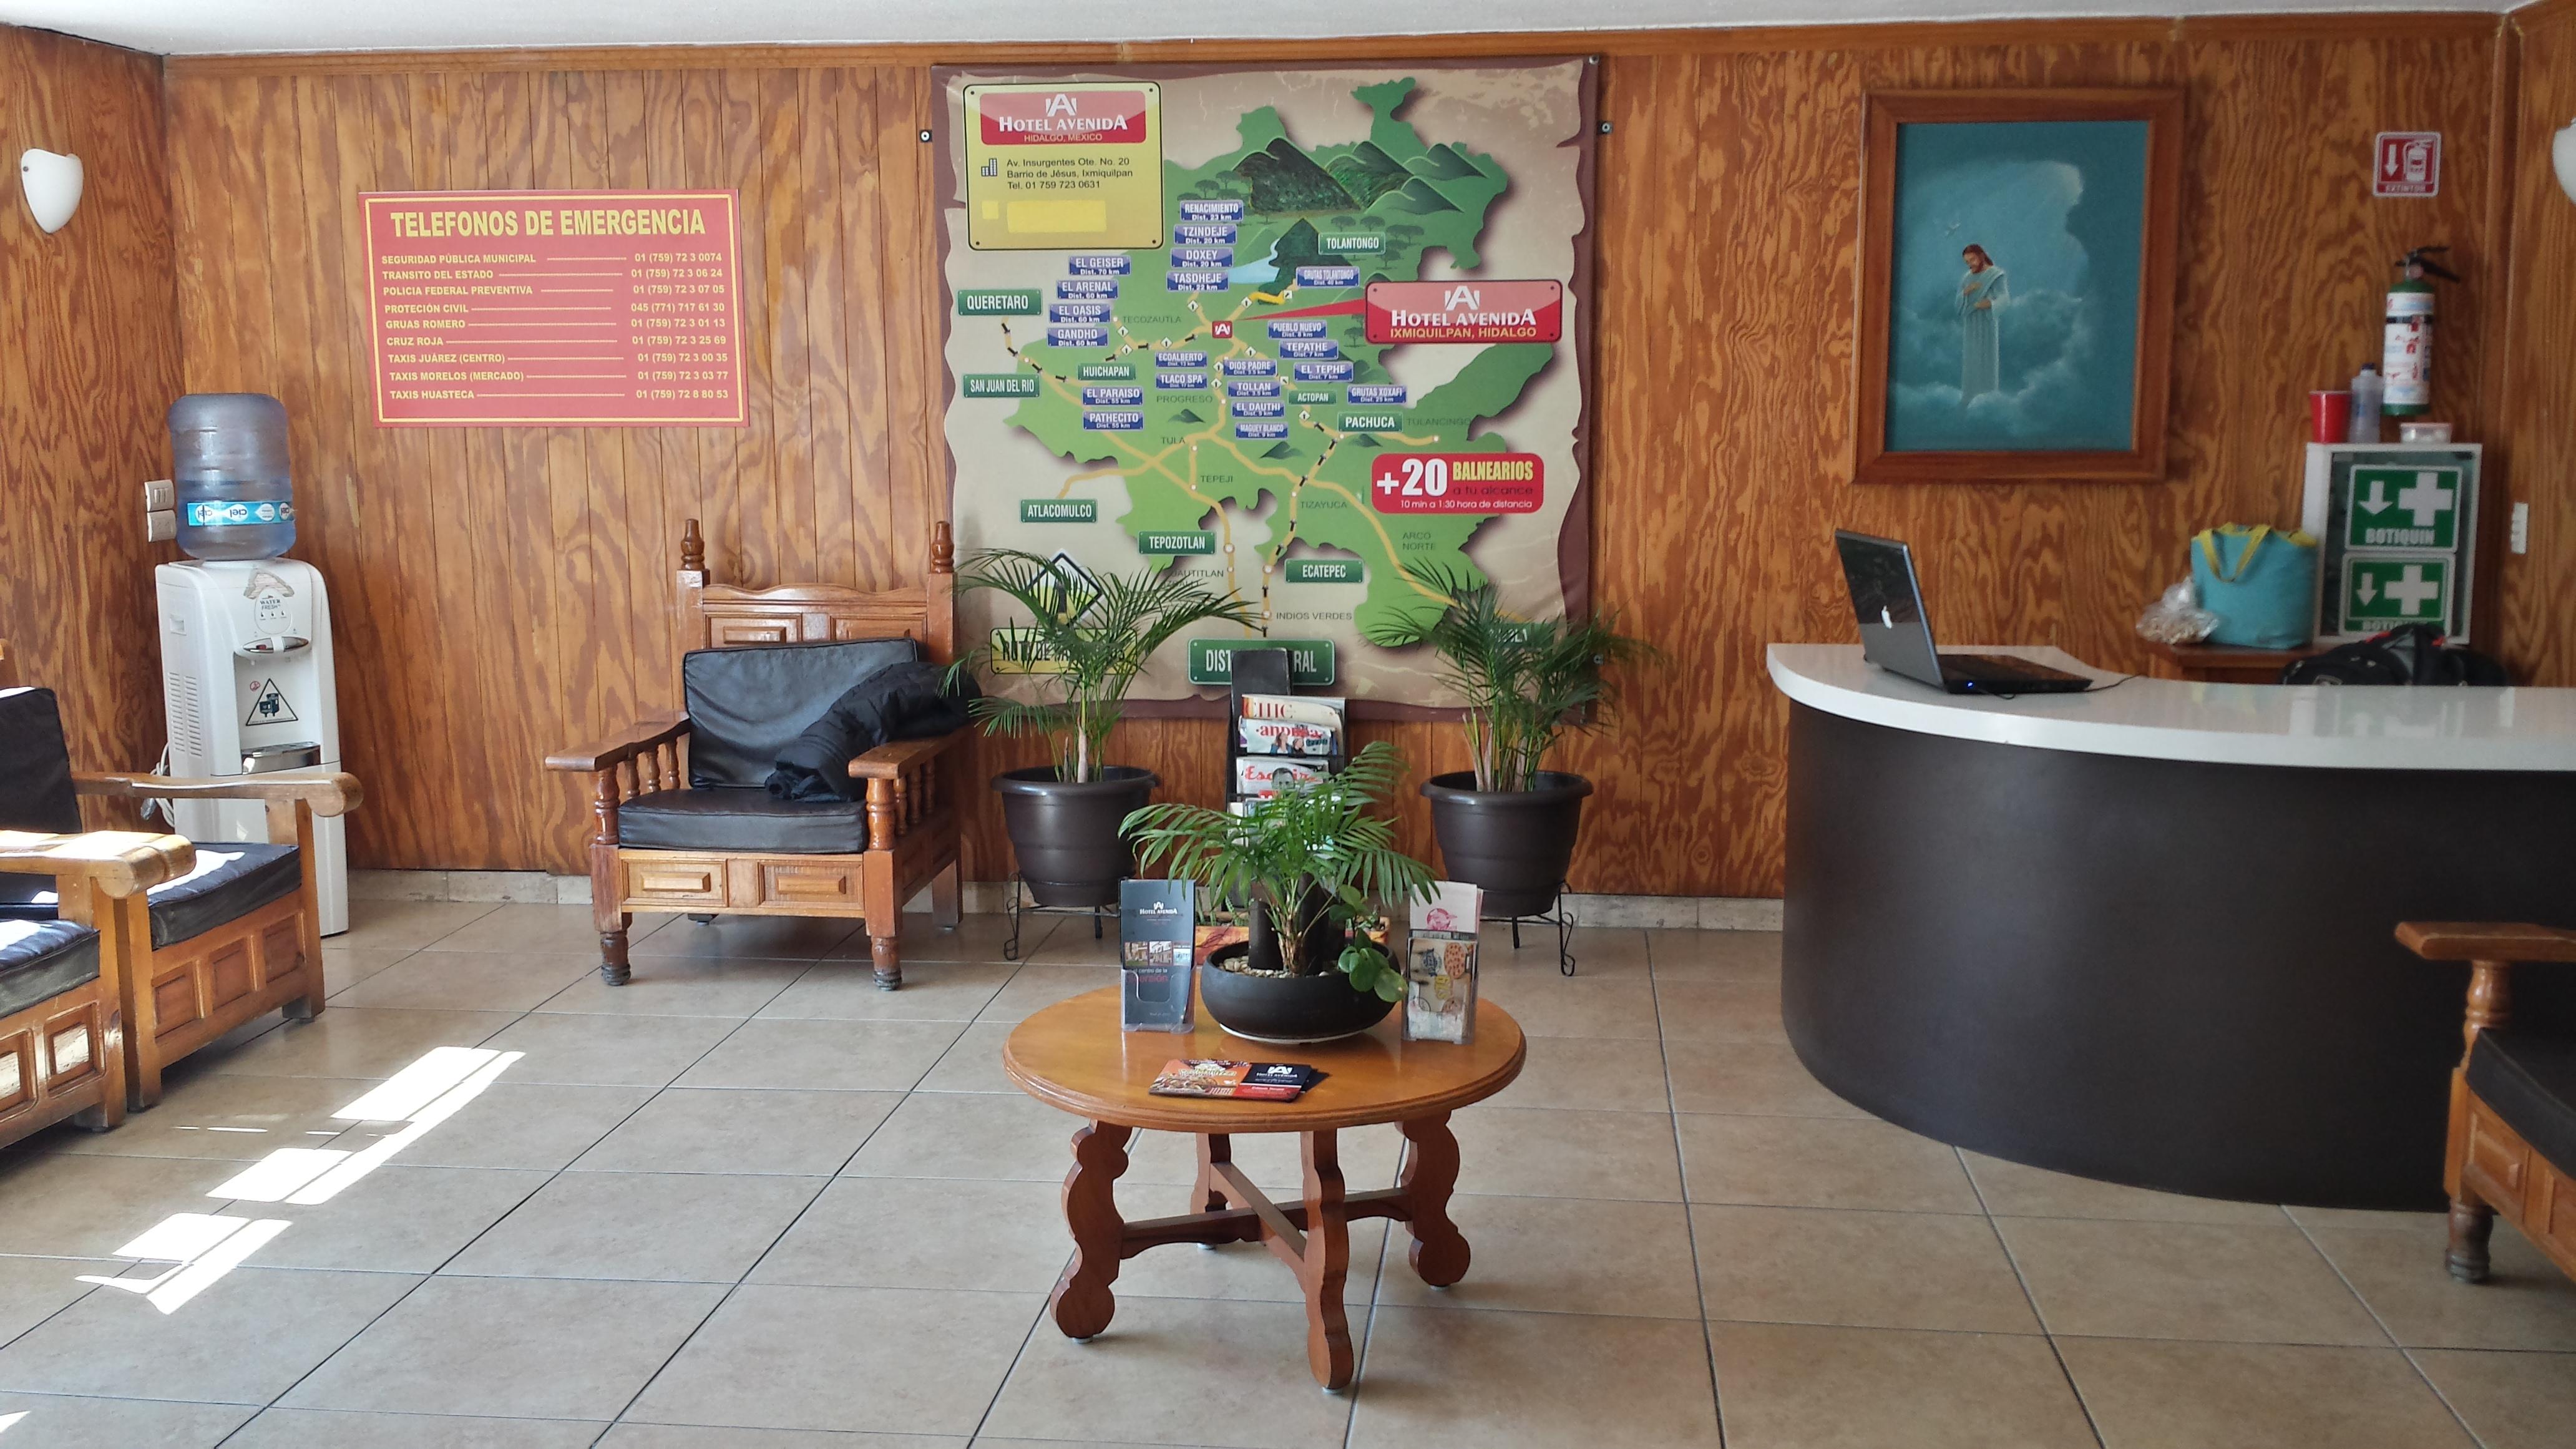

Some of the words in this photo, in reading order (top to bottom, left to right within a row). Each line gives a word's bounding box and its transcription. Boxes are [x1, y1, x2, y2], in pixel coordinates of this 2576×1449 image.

[1024, 134, 1065, 142] HIDALGO,
[1007, 159, 1020, 167] Av.
[1023, 158, 1075, 168] Insurgentes
[1007, 170, 1033, 178] Barrio
[1050, 170, 1079, 178] Jésus,
[1082, 169, 1133, 178] Ixmiquilpan
[1008, 182, 1023, 190] Tel.
[1025, 181, 1035, 189] 01
[1185, 203, 1238, 213] RENACIMIENTO
[391, 210, 518, 237] TELEFONOS
[525, 210, 554, 235] DE
[560, 208, 705, 236] EMERGENCIA
[1183, 226, 1227, 236] TZINDEJE
[1327, 237, 1378, 249] TOLANTONGO
[382, 255, 436, 264] SEGURIDAD
[439, 255, 481, 263] PÚBLICA
[483, 254, 536, 263] MUNICIPAL
[635, 253, 645, 261] 01
[649, 253, 673, 263] (759)
[676, 253, 687, 261] 72
[690, 253, 696, 261] 3
[699, 253, 721, 261] 0074
[1186, 250, 1217, 260] DOXEY
[1076, 258, 1086, 268] EL
[1090, 257, 1124, 268] GEISER
[383, 271, 431, 280] TRANSITO
[434, 271, 452, 279] DEL
[456, 270, 493, 279] ESTADO
[1174, 273, 1221, 283] TASDHEJE
[384, 287, 422, 295] POLICIA
[425, 286, 468, 295] FEDERAL
[471, 286, 532, 295] PREVENTIVA
[1062, 282, 1073, 291] EL
[1076, 281, 1113, 291] ARENAL
[967, 295, 1028, 310] QUERETARO
[385, 304, 440, 313] PROTECIÓN
[443, 305, 468, 313] CIVIL
[632, 303, 648, 311] 045
[651, 303, 675, 313] (771)
[713, 303, 724, 311] 30
[1059, 306, 1070, 315] EL
[1073, 306, 1101, 315] OASIS
[386, 320, 419, 328] GRUAS
[423, 320, 466, 328] ROMERO
[1273, 323, 1298, 332] PUEBLO
[1300, 323, 1322, 331] NUEVO
[1058, 329, 1097, 339] GANDHO
[1390, 328, 1474, 339] IXMIQUILPAN,
[1478, 327, 1536, 338] HIDALGO
[387, 338, 414, 346] CRUZ
[417, 337, 443, 346] ROJA
[633, 336, 643, 344] 01
[648, 336, 671, 346] (759)
[675, 336, 687, 344] 72
[690, 336, 696, 344] 3
[700, 336, 711, 344] 25
[714, 336, 726, 344] 69
[1287, 343, 1327, 351] TEPATHE
[388, 354, 416, 363] TAXIS
[419, 353, 457, 363] JUÁREZ
[459, 354, 505, 364] (CENTRO)
[1159, 353, 1203, 361] ECOALBERTO
[1229, 361, 1246, 370] DIOS
[1247, 361, 1271, 370] PADRE
[1302, 365, 1312, 373] EL
[1315, 364, 1345, 373] TEPHE
[1083, 366, 1129, 376] HUICHAPAN
[389, 373, 417, 381] TAXIS
[421, 372, 467, 381] MORELOS
[470, 372, 524, 382] (MERCADO)
[1161, 374, 1185, 384] TLACO
[1188, 374, 1203, 383] SPA
[971, 379, 985, 392] SAN
[987, 379, 1005, 392] JUAN
[1007, 379, 1020, 392] DEL
[1022, 379, 1033, 392] RIO
[390, 391, 418, 399] TAXIS
[422, 391, 474, 399] HUASTECA
[1087, 389, 1097, 398] EL
[1100, 389, 1139, 398] PARAISO
[1298, 393, 1328, 401] ACTOPAN
[1352, 388, 1377, 396] GRUTAS
[1378, 388, 1402, 396] XOXAFI
[1157, 395, 1212, 403] PROGRESO
[1236, 402, 1246, 411] EL
[1249, 402, 1280, 411] DAUTHI
[1090, 413, 1139, 422] PATHECITO
[1345, 417, 1394, 427] PACHUCA
[1453, 461, 1533, 481] BALNEARIOS
[1377, 459, 1447, 495] +20
[1466, 485, 1477, 495] tu
[1301, 501, 1347, 509] TIZAYUCA
[1401, 500, 1410, 508] 10
[1412, 500, 1427, 508] min
[1456, 500, 1477, 508] hora
[1479, 500, 1491, 508] de
[1493, 500, 1533, 508] distancia
[230, 508, 247, 517] ciel
[1028, 504, 1091, 517] ATLACOMULCO
[1403, 532, 1431, 540] ARCO
[2365, 528, 2435, 545] BOTIQUIN
[1149, 536, 1204, 549] TEPOZOTLAN
[1303, 565, 1345, 577] ECATEPEC
